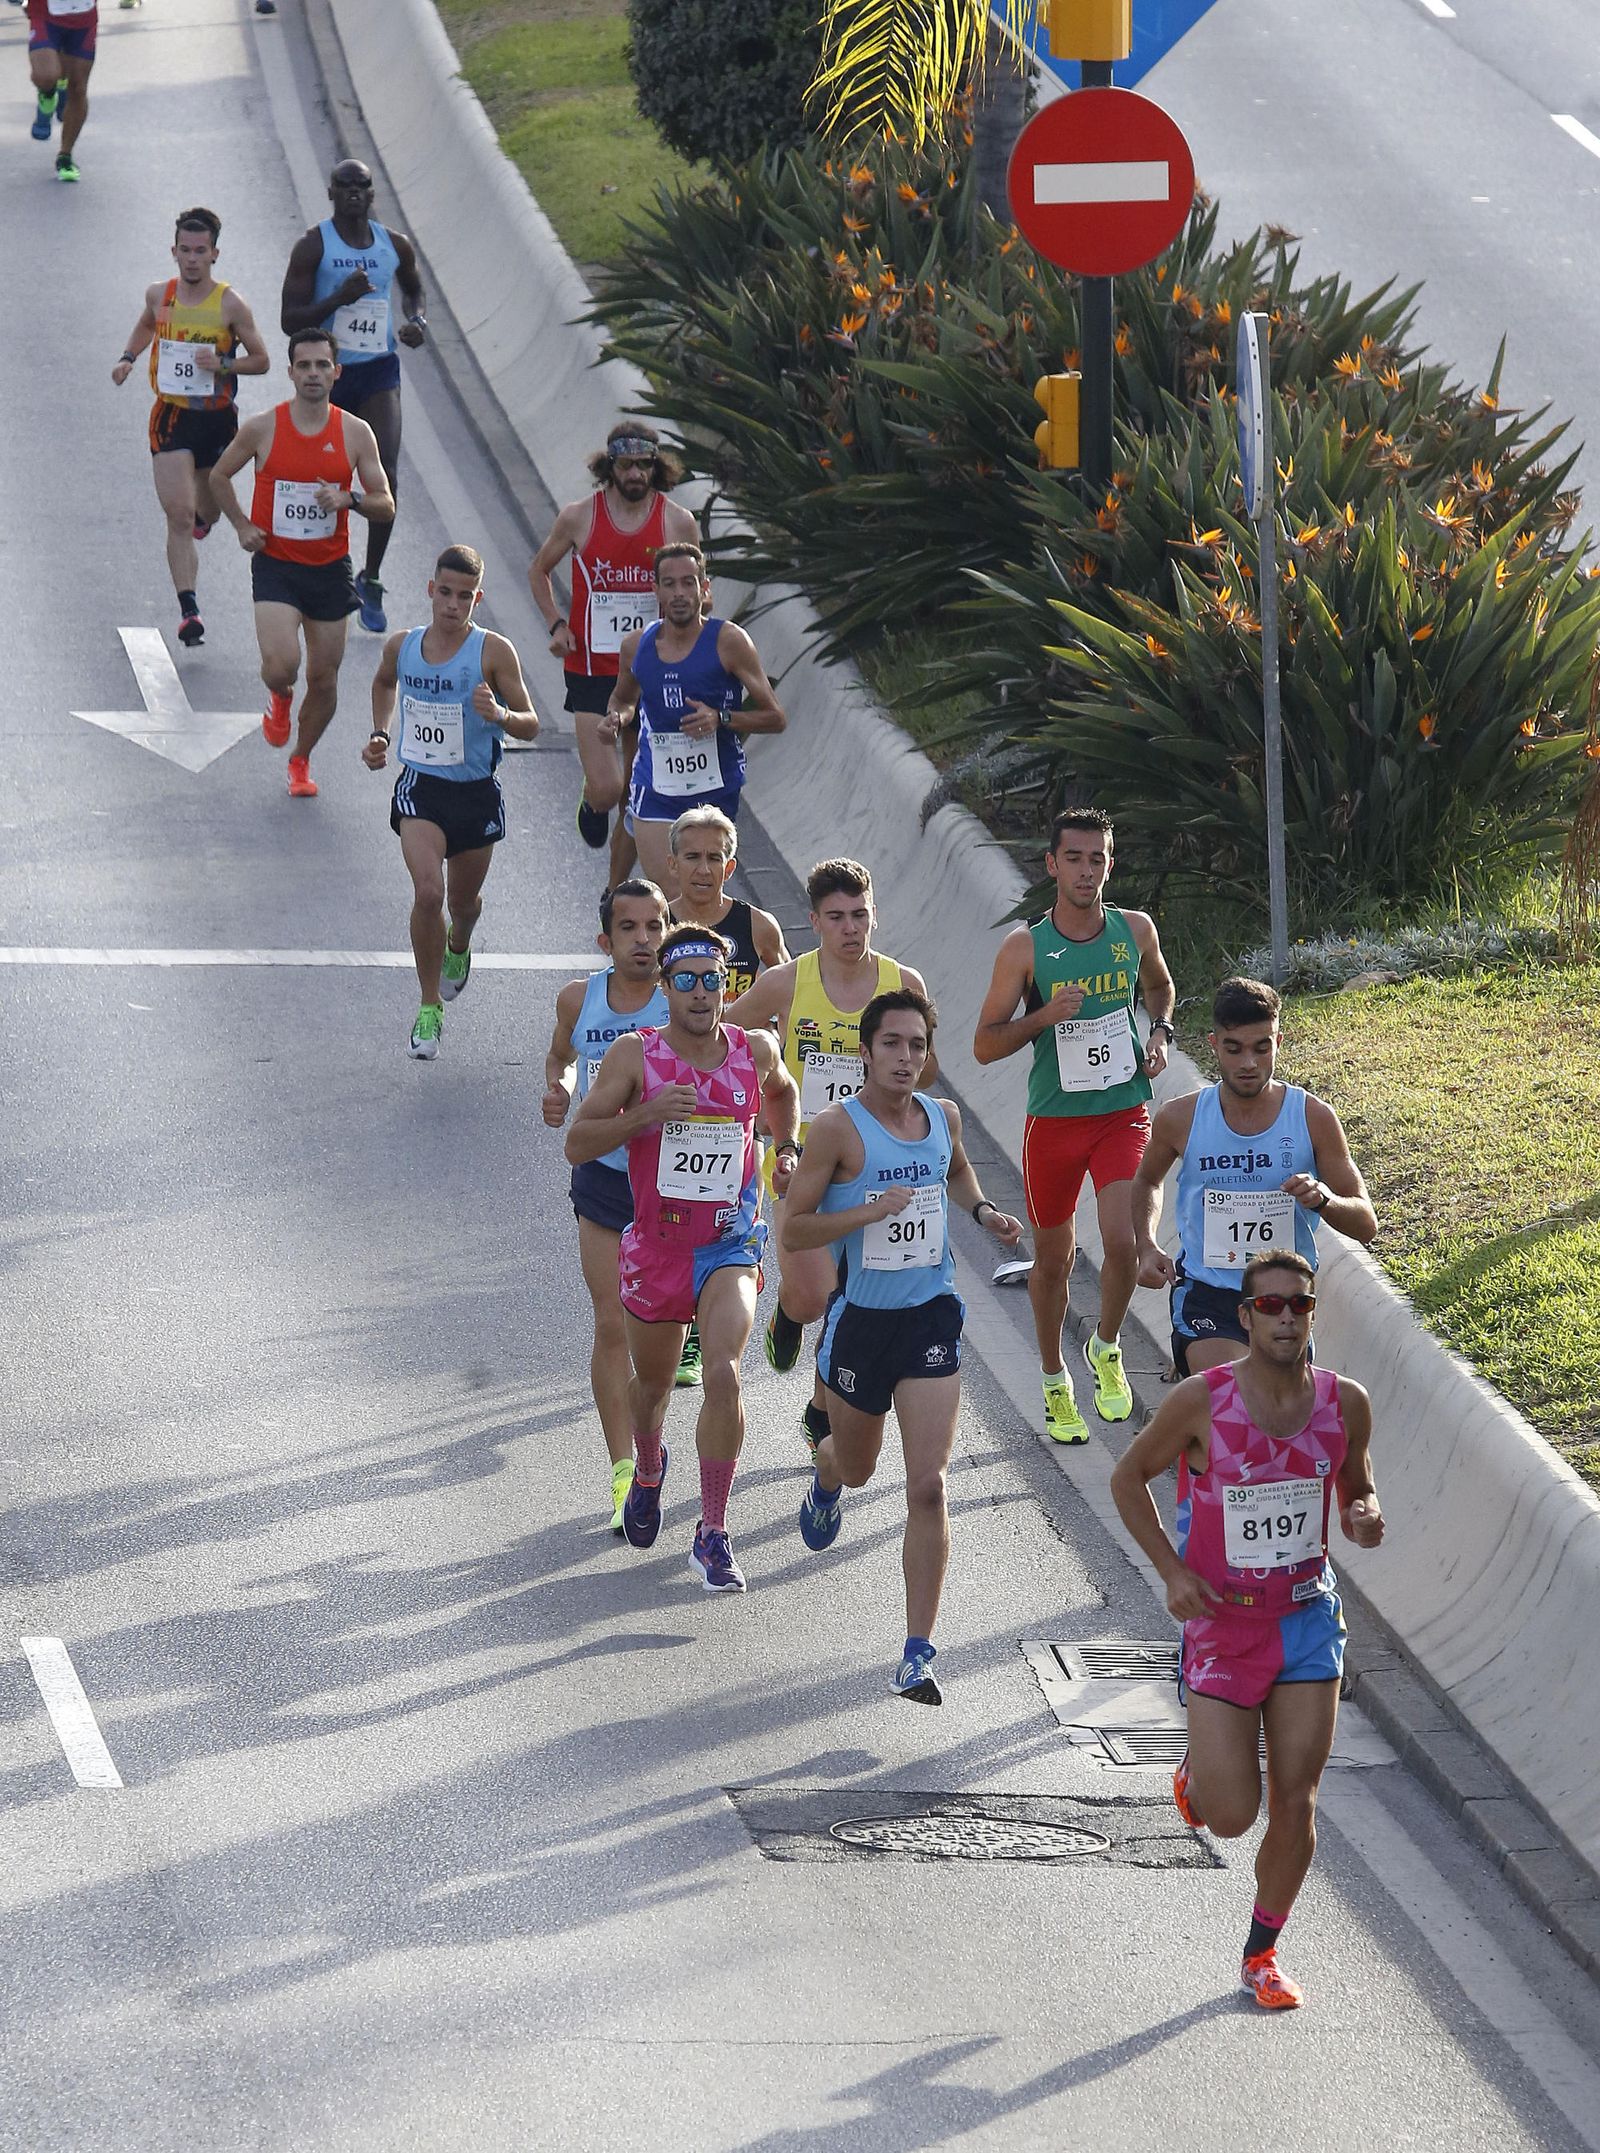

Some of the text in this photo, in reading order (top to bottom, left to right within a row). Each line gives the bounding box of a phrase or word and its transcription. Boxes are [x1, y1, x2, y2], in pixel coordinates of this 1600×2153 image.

[333, 256, 378, 271] nerja
[348, 319, 376, 334] 444
[174, 363, 194, 378] 58
[609, 616, 644, 632] 120
[414, 724, 445, 744] 300
[665, 753, 707, 774] 1950
[794, 1028, 823, 1038] Vopak
[1088, 1044, 1110, 1066] 56
[673, 1151, 733, 1175] 2077
[878, 1161, 932, 1182] nerja
[1199, 1149, 1273, 1174] nerja
[887, 1219, 926, 1244] 301
[1228, 1221, 1274, 1242] 176
[1242, 1512, 1308, 1541] 8197
